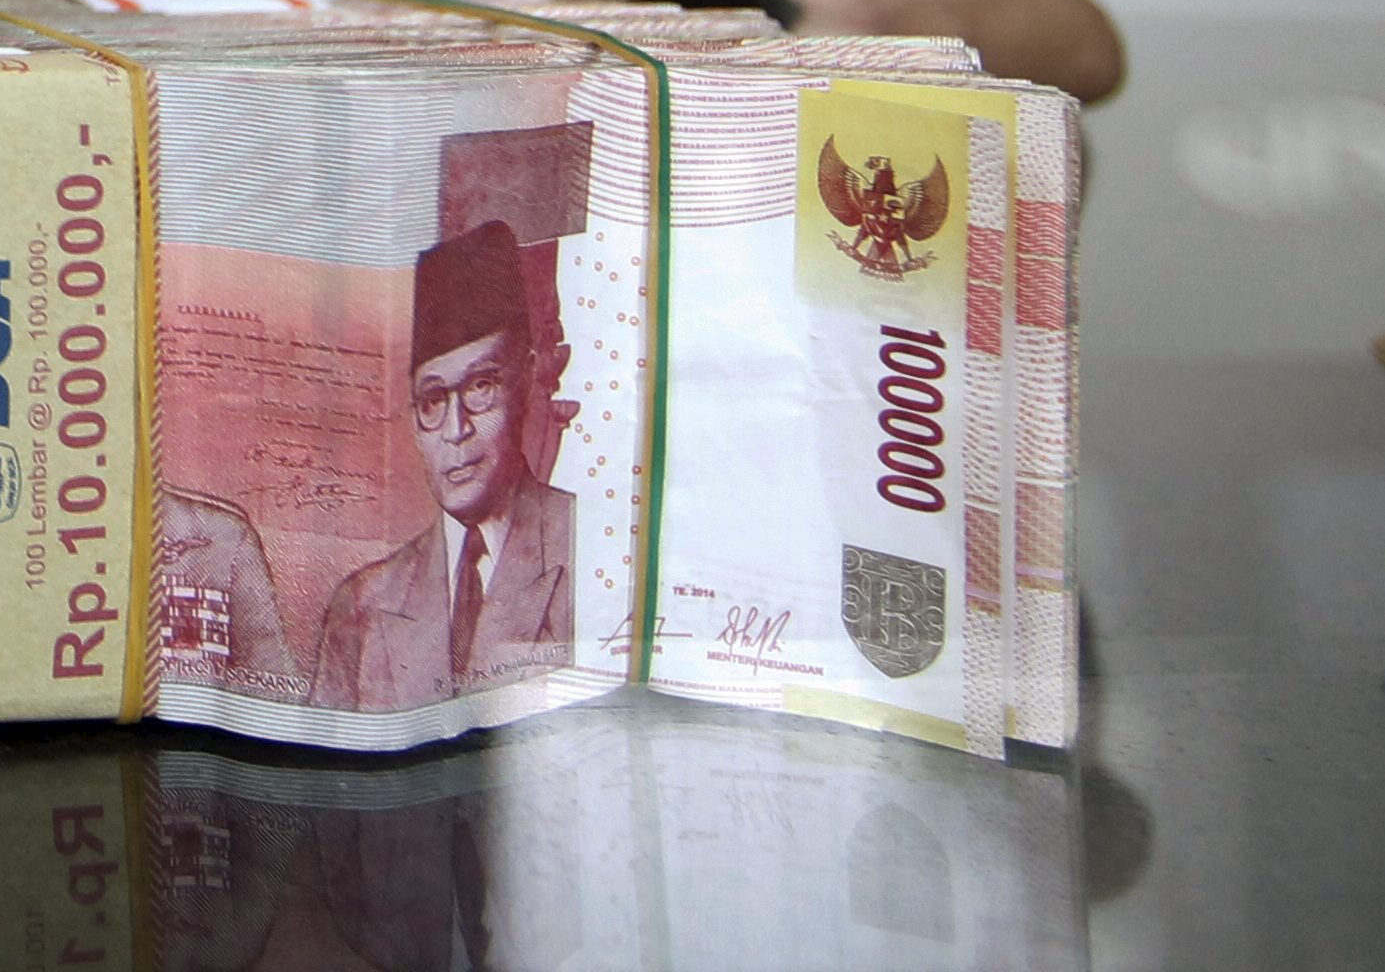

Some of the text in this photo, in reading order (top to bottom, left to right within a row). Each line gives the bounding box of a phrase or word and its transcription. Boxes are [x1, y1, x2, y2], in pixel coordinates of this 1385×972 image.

[27, 351, 52, 394] Rp.
[52, 124, 119, 679] Rp.10.000.000,-
[876, 324, 947, 514] 100000
[27, 439, 47, 536] Lembar
[25, 543, 46, 590] 100
[759, 657, 824, 677] KEUANGAN
